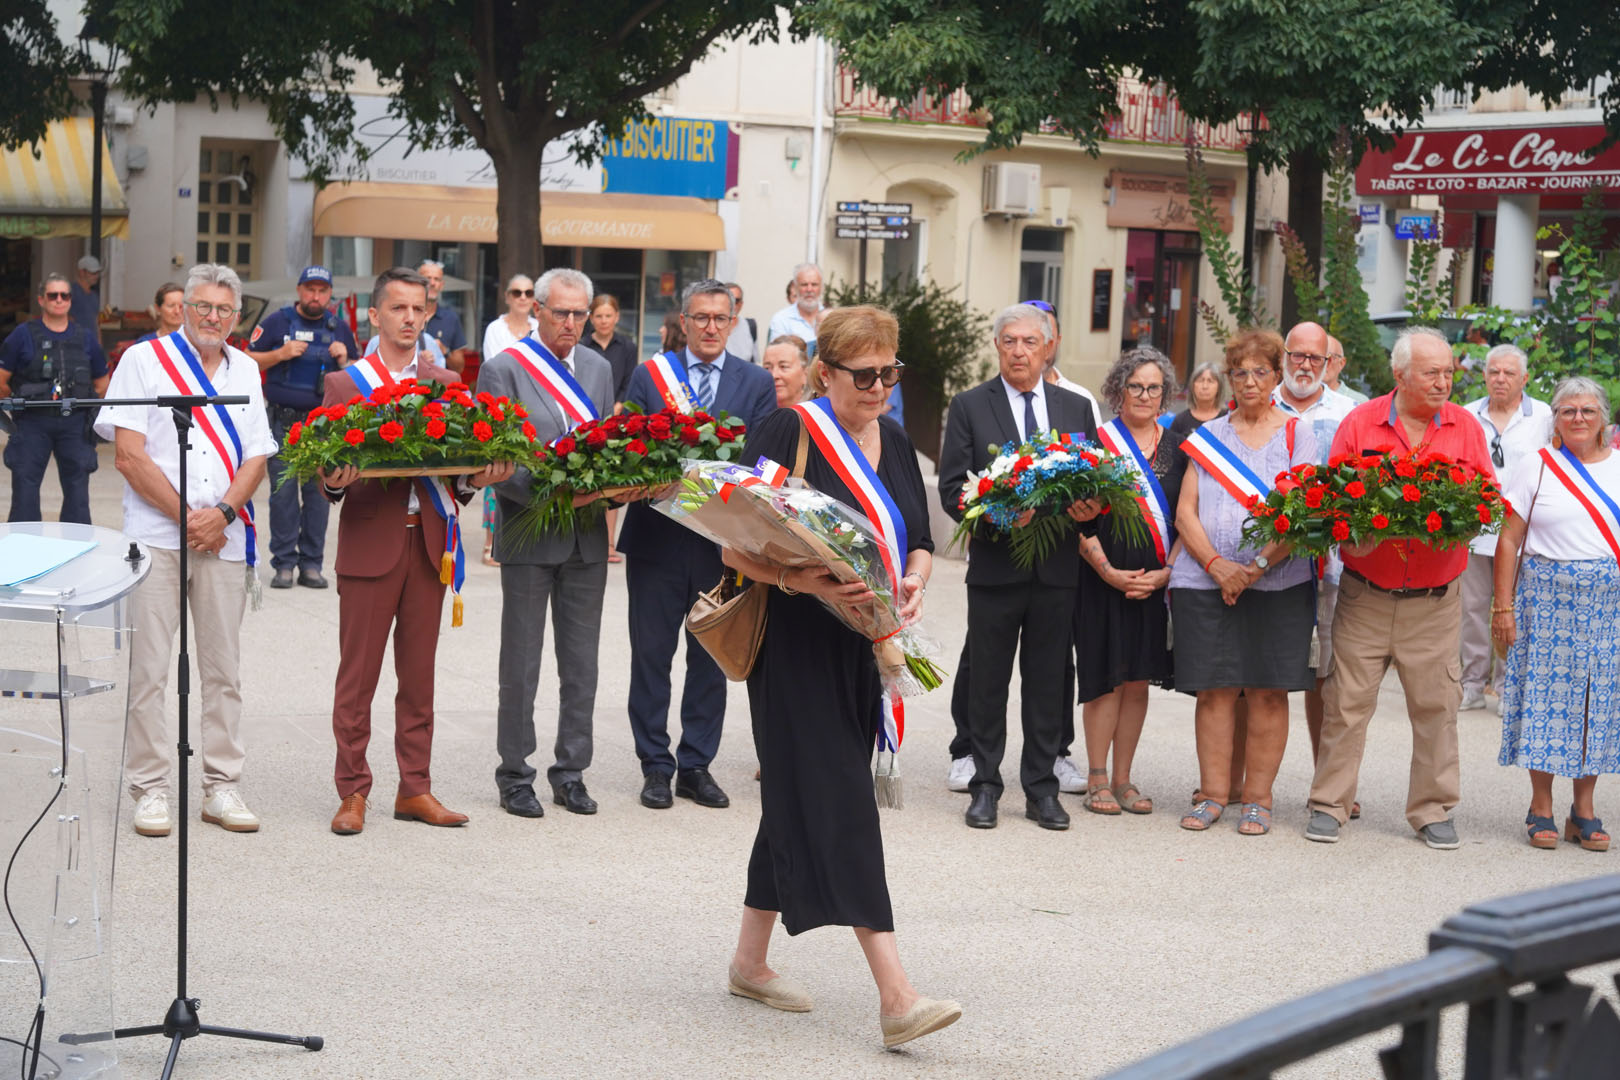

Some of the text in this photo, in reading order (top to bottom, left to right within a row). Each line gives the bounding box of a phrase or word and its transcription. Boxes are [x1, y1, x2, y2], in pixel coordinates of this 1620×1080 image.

[622, 119, 715, 162] BISCUITIER
[1392, 135, 1444, 172] Le
[1371, 179, 1416, 190] TABAC
[1427, 178, 1465, 190] LOTO
[1477, 177, 1527, 189] BAZAR
[426, 215, 451, 231] LA
[545, 219, 653, 238] GOURMANDE
